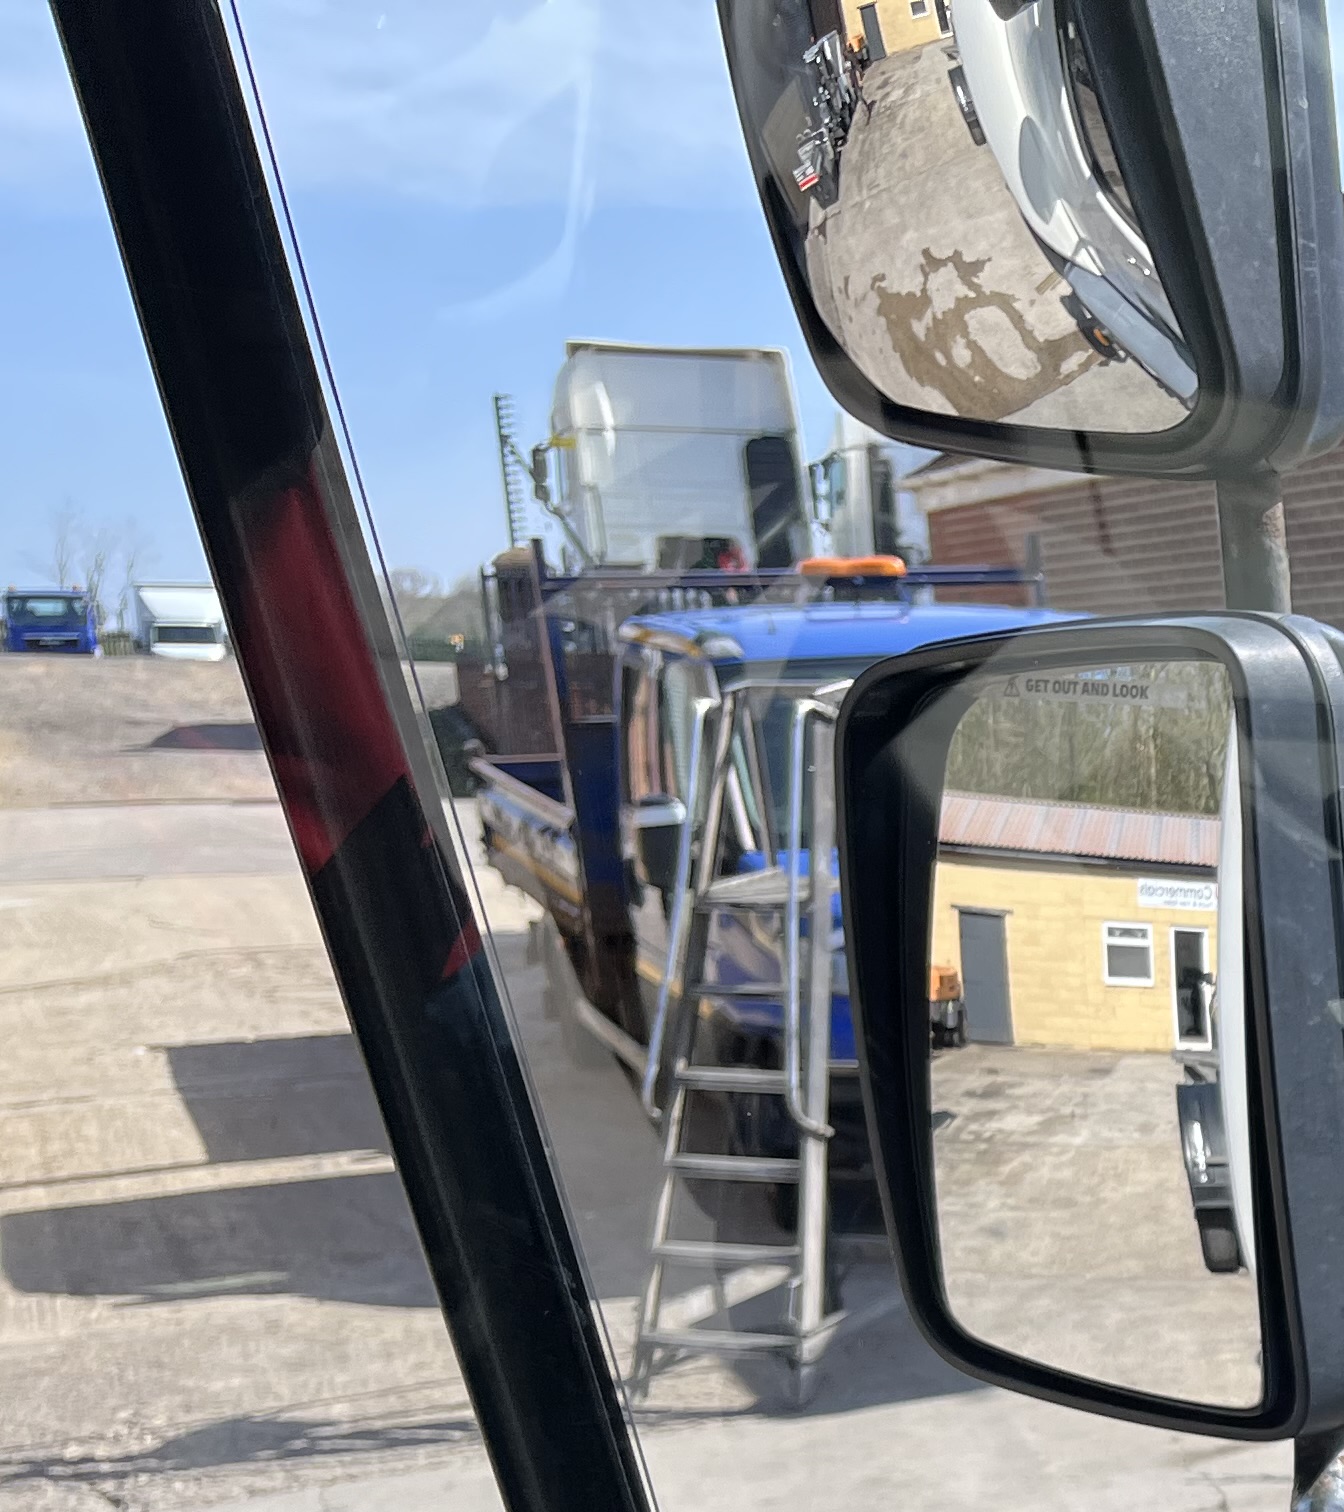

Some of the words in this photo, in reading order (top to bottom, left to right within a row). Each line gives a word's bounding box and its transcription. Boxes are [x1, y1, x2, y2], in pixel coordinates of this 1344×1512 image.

[1025, 679, 1050, 693] GET
[1052, 680, 1080, 695] OUT
[1081, 683, 1109, 697] AND
[1112, 684, 1150, 700] LOOK
